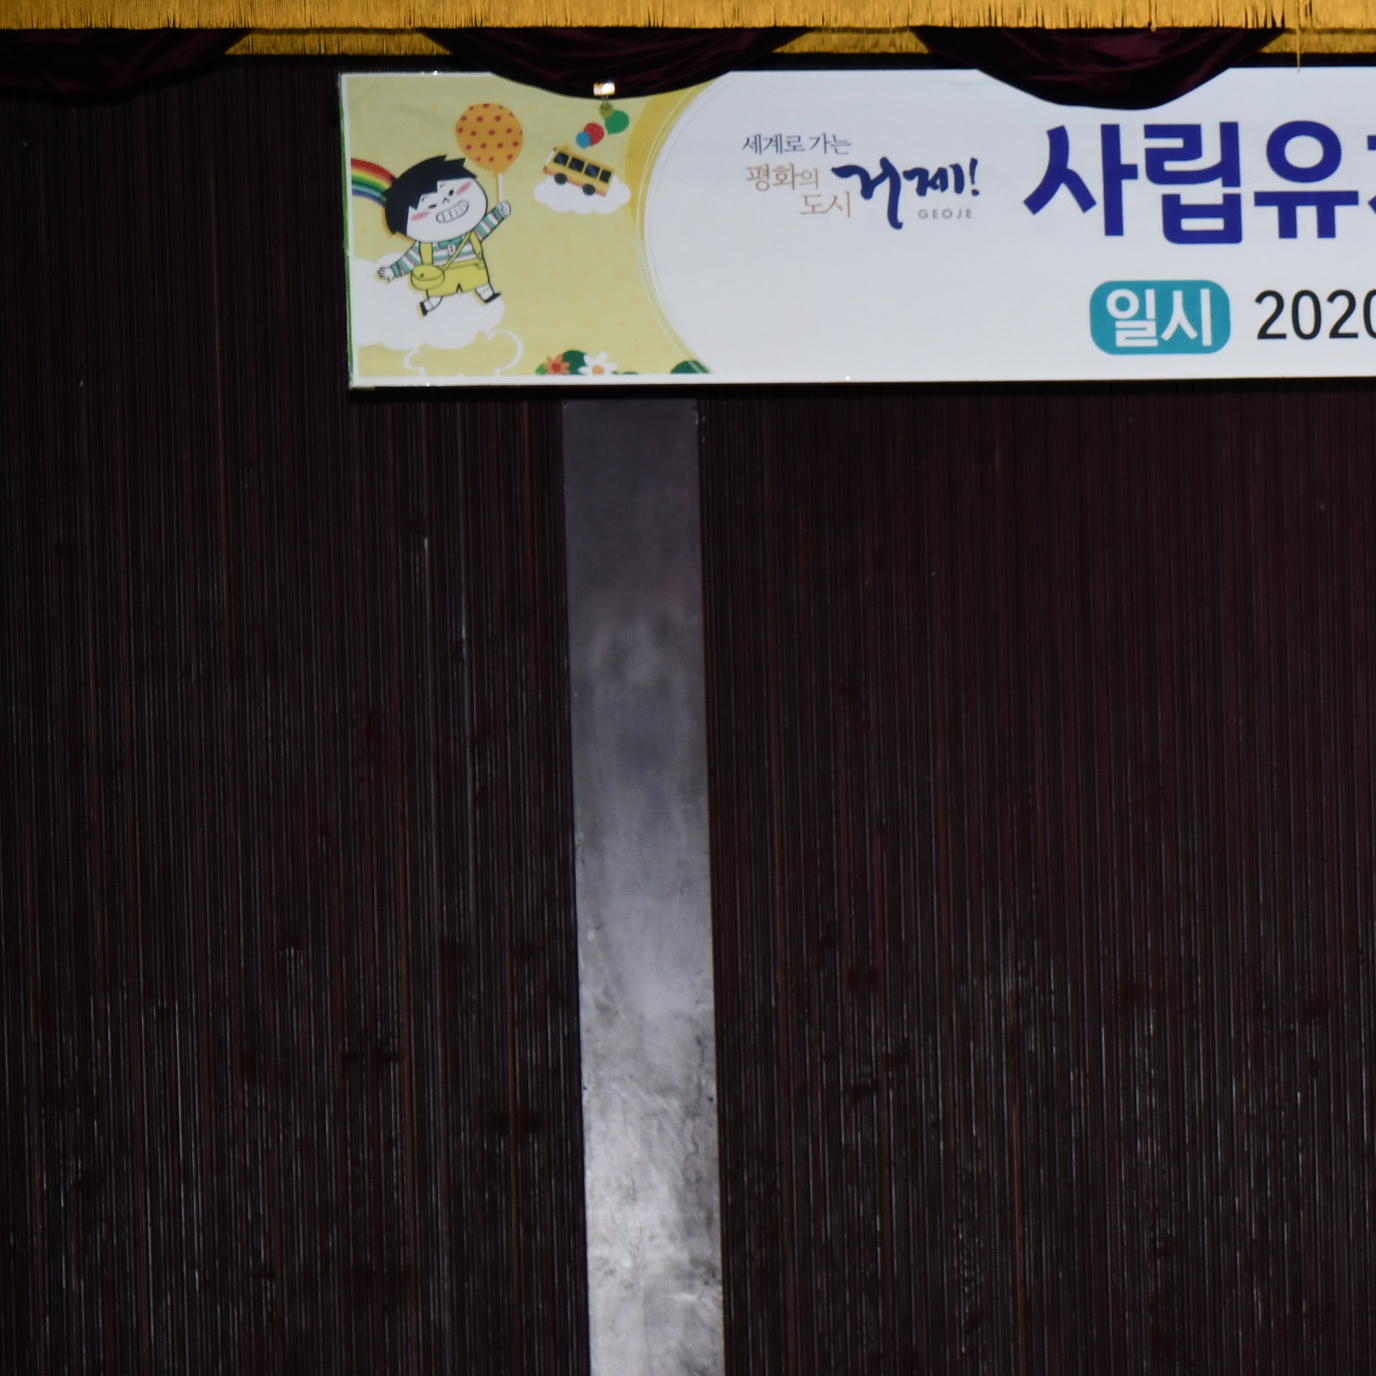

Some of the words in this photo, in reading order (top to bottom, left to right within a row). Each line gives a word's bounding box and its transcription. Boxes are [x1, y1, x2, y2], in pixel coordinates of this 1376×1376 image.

[742, 133, 805, 155] 세계로
[808, 132, 852, 155] 가는
[746, 163, 819, 192] 평화의
[800, 191, 851, 218] 도시
[831, 157, 980, 230] 거제!
[918, 208, 972, 220] GEOJE
[1105, 288, 1213, 348] 일시
